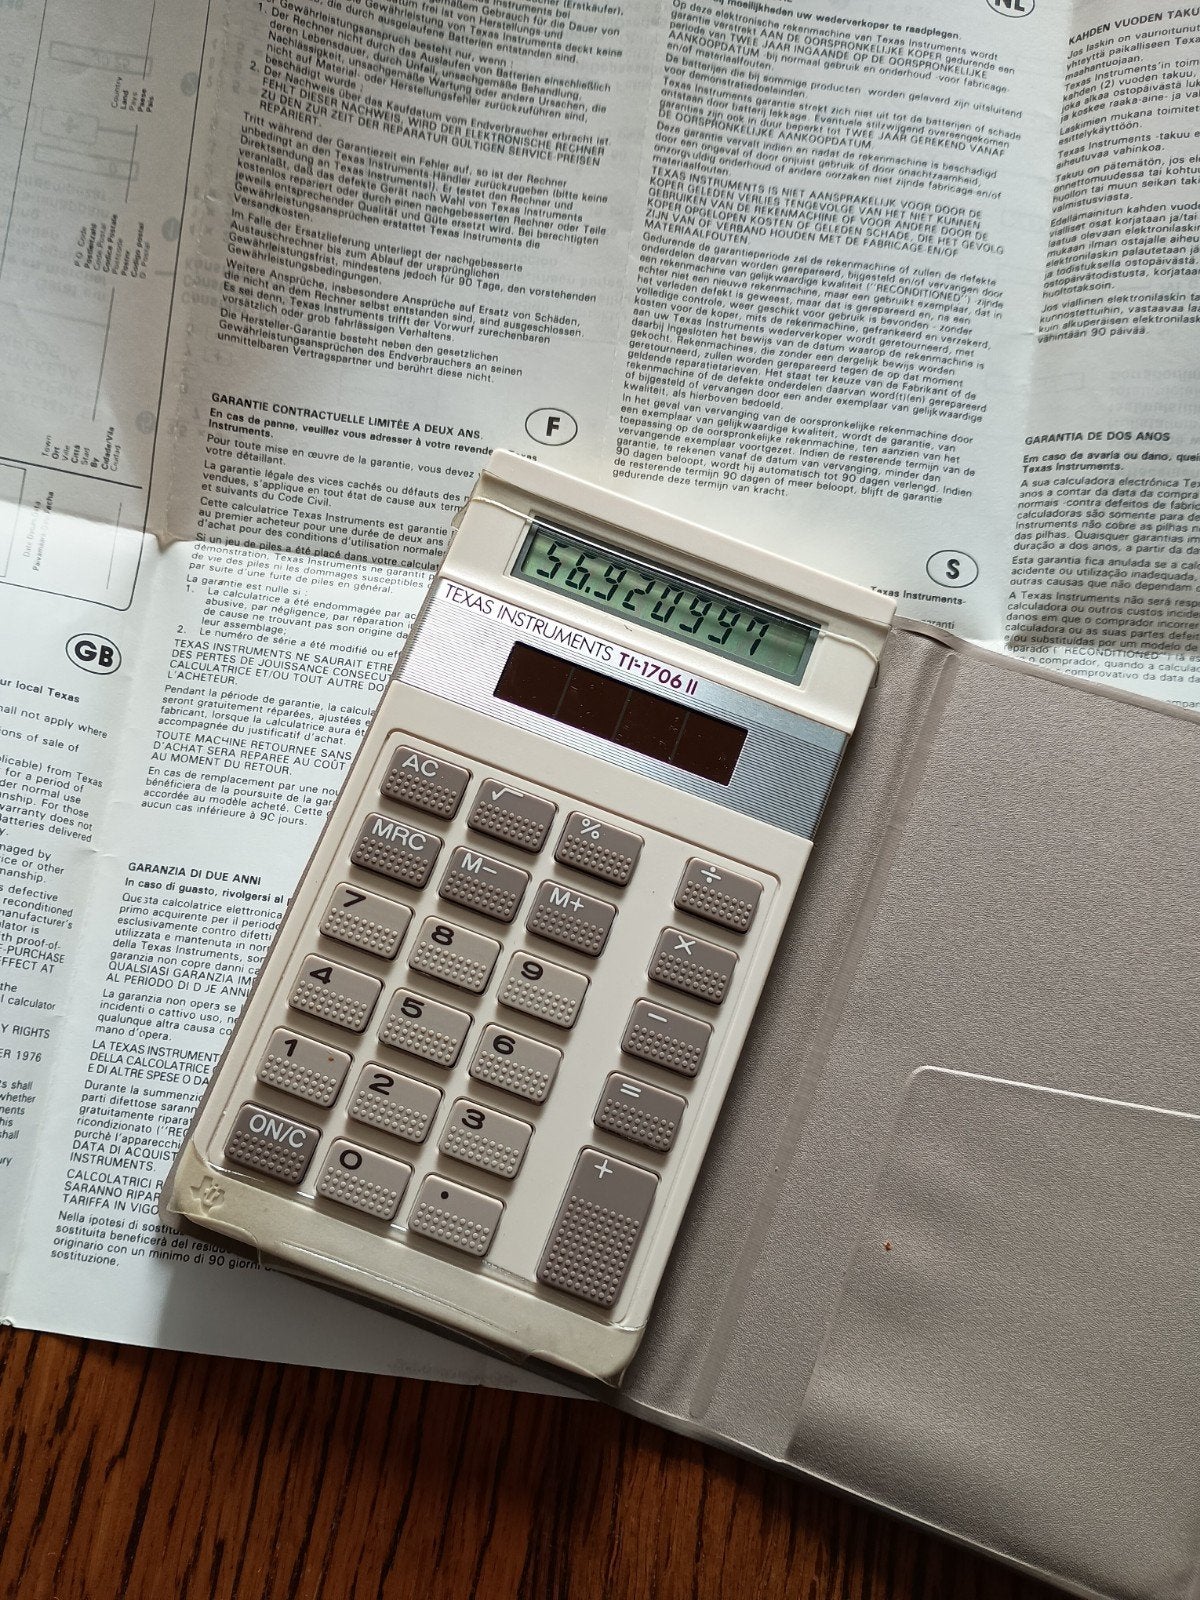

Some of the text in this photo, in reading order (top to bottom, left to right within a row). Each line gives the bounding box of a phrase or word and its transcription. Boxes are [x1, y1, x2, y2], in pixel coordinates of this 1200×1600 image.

[796, 11, 813, 20] uw
[815, 14, 889, 30] wederverkoper
[892, 22, 902, 31] te
[905, 25, 959, 39] raadplegen.
[1068, 7, 1200, 46] KAHDEN VUODEN TAKU
[120, 90, 129, 110] Land
[644, 217, 750, 245] MATERIAALFOUTEN.
[216, 331, 493, 383] unmittelbaren Vertragspartner und berührt diese nicht.
[211, 391, 483, 439] GARANTIE CONTRACTUELLE LIMITÉE A DEUX ANS.
[208, 418, 273, 438] Instruments.
[209, 406, 451, 450] En cas de panne, veuillez vous adresser à votre
[546, 417, 561, 436] F
[1024, 430, 1171, 445] GARANTIA DE DOS ANOS
[52, 446, 60, 460] Ort
[90, 457, 100, 468] By
[205, 445, 286, 466] votre détaillant.
[206, 432, 474, 478] Pour toute mise en œuvre de la garantie, vous devez
[1022, 450, 1172, 463] Em caso de avaria ou dano,
[615, 445, 972, 497] 90 dagen beloopt, wordt hij automatisch tot 90 dagen verlengd. Indien
[1021, 461, 1124, 474] Texas Instruments.
[611, 469, 788, 496] gedurende deze termijn van kracht.
[946, 559, 960, 580] S
[536, 541, 770, 656] 56.920997
[200, 616, 287, 635] leur assemblage;
[444, 584, 698, 696] TEXAS INSTRUMENTS TI-1706 II
[74, 640, 114, 668] GB
[174, 638, 392, 672] TEXAS INSTRUMENTS NE SAURAIT ETRE
[167, 670, 237, 685] L'ACHETEUR.
[16, 680, 80, 703] local Texas
[21, 710, 108, 738] not apply where
[156, 729, 191, 742] TOUTE
[250, 739, 317, 757] RETOURNEE
[320, 748, 352, 761] SANS
[47, 764, 103, 788] from Texas
[401, 754, 439, 777] AC
[48, 826, 92, 842] delivered
[372, 819, 427, 850] MRC
[581, 818, 600, 840] %
[127, 861, 261, 885] GARANZIA DI DUE ANNI
[8, 886, 58, 902] defective
[124, 876, 284, 904] In caso di guasto, rivolgersi al
[344, 890, 366, 907] 7
[550, 888, 584, 912] M+
[2, 897, 73, 918] reconditioned
[431, 925, 454, 946] 8
[310, 967, 334, 984] 4
[521, 960, 544, 981] 9
[8, 997, 56, 1010] calculator
[401, 996, 424, 1018] 5
[12, 1024, 50, 1038] RIGHTS
[284, 1039, 298, 1057] 1
[493, 1034, 516, 1054] 6
[16, 1050, 42, 1062] 1976
[368, 1074, 394, 1096] 2
[620, 1083, 642, 1098] =
[462, 1108, 486, 1130] 3
[249, 1114, 307, 1149] ON/C
[69, 1151, 156, 1172] INSTRUMENTS.
[340, 1150, 362, 1170] 0
[594, 1158, 613, 1178] +
[50, 1249, 119, 1267] sostituzione.
